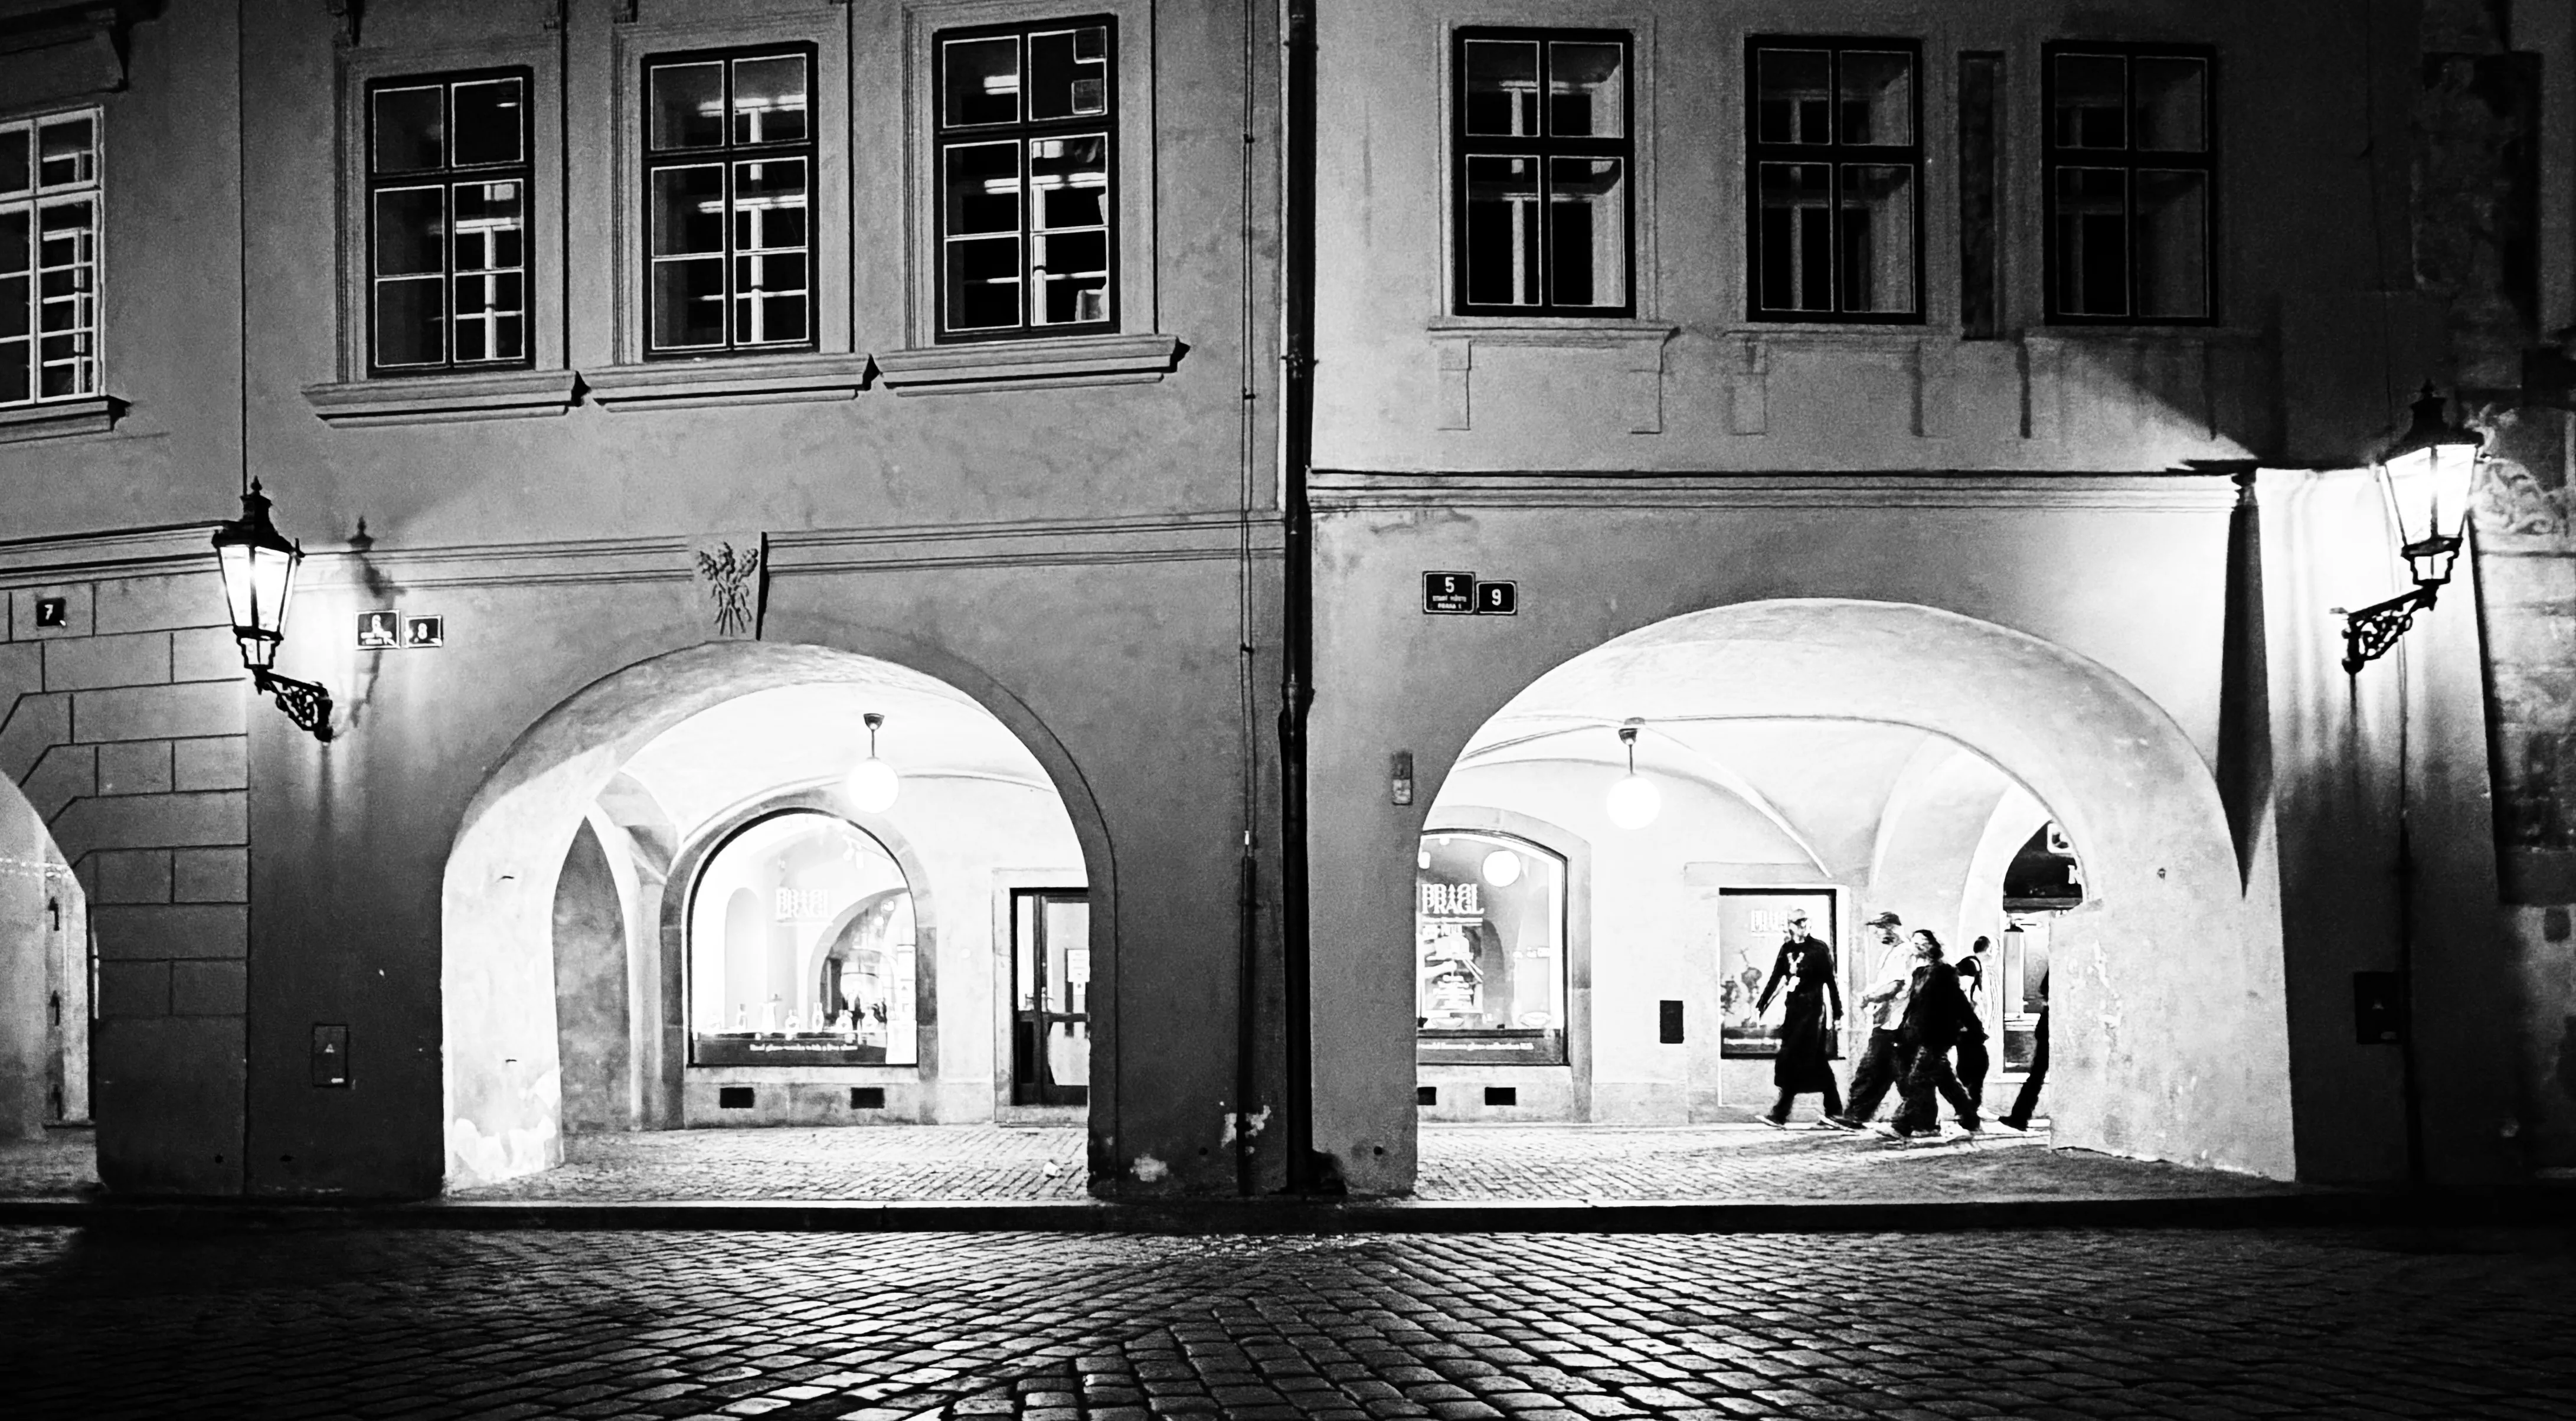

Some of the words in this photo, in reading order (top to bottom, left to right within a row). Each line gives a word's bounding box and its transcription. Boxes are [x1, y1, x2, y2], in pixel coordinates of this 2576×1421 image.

[1445, 577, 1455, 593] 5
[1492, 589, 1501, 606] 9
[44, 604, 53, 620] 7
[418, 623, 427, 639] 8
